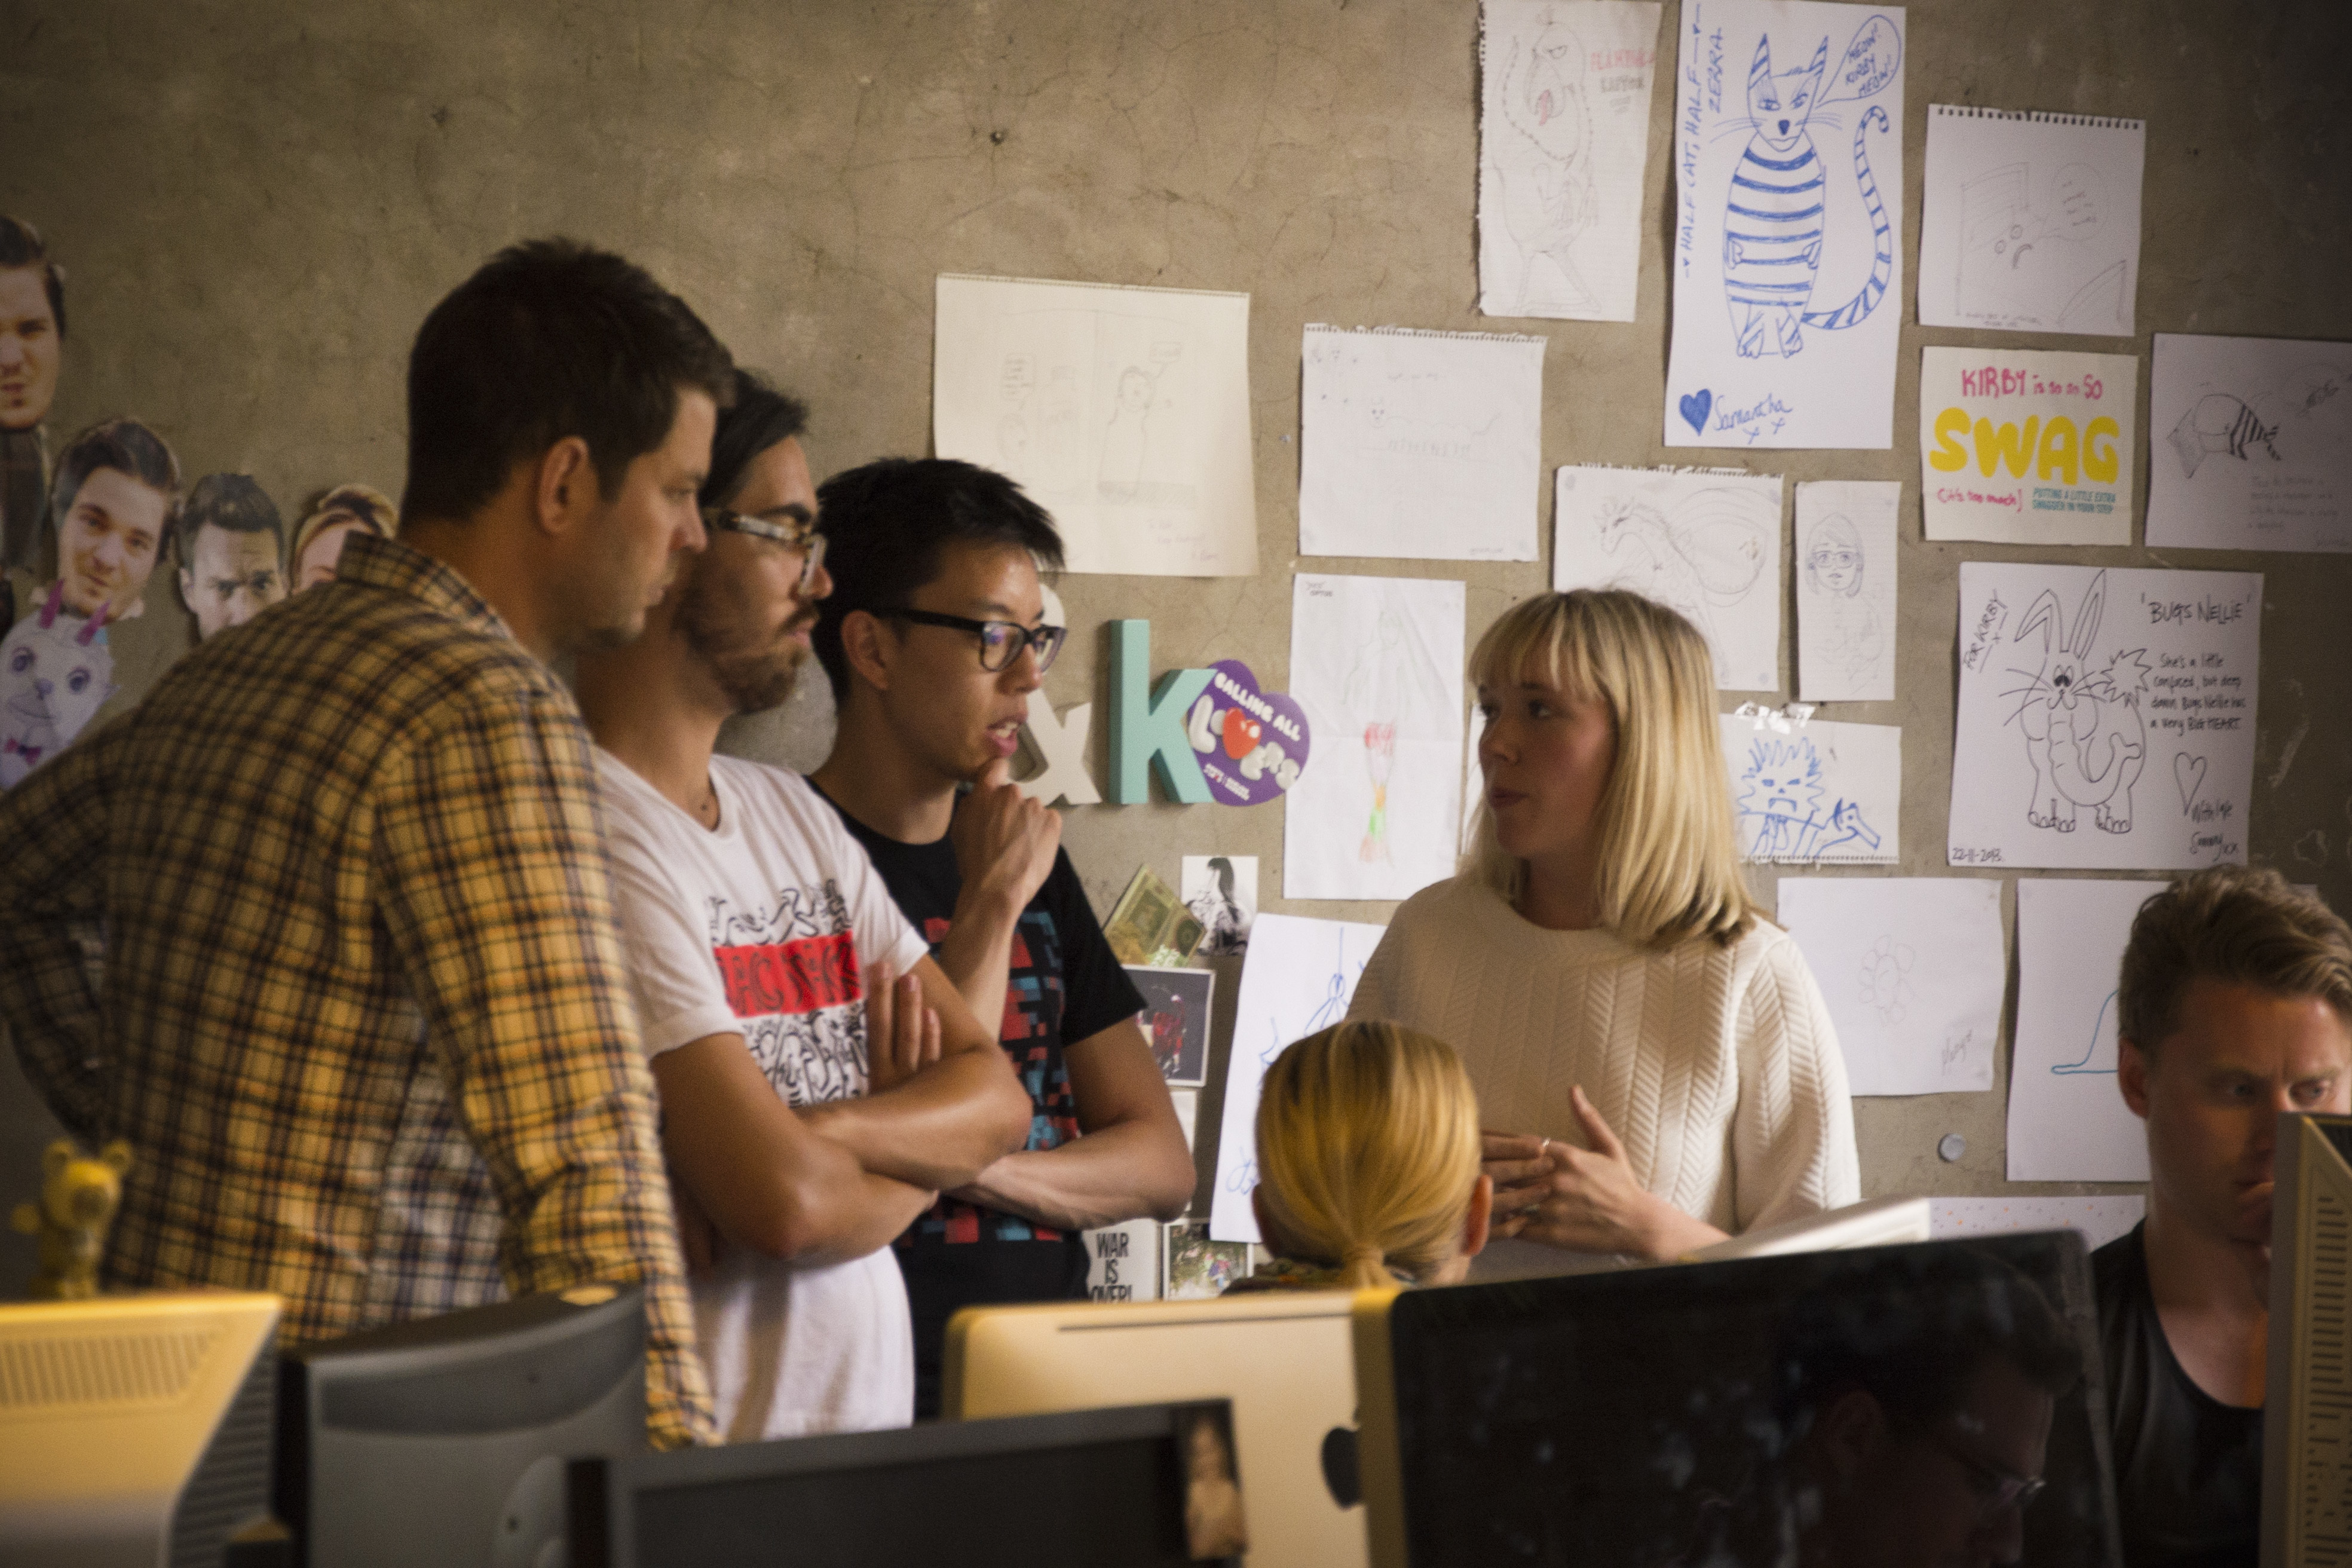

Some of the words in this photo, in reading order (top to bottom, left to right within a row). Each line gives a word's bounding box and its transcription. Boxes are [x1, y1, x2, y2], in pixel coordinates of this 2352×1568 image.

[1685, 66, 1702, 136] HALF
[1682, 141, 1700, 187] CAT,
[1680, 194, 1695, 251] HALF
[1962, 366, 2027, 399] KIRBY
[1713, 393, 1793, 431] Samantha
[1929, 406, 2120, 486] SWAG
[1974, 588, 2008, 643] KIRBY
[1214, 672, 1273, 722] CALLING
[1273, 715, 1301, 742] ALL
[1096, 1232, 1129, 1258] WAR
[1105, 1258, 1118, 1284] IS
